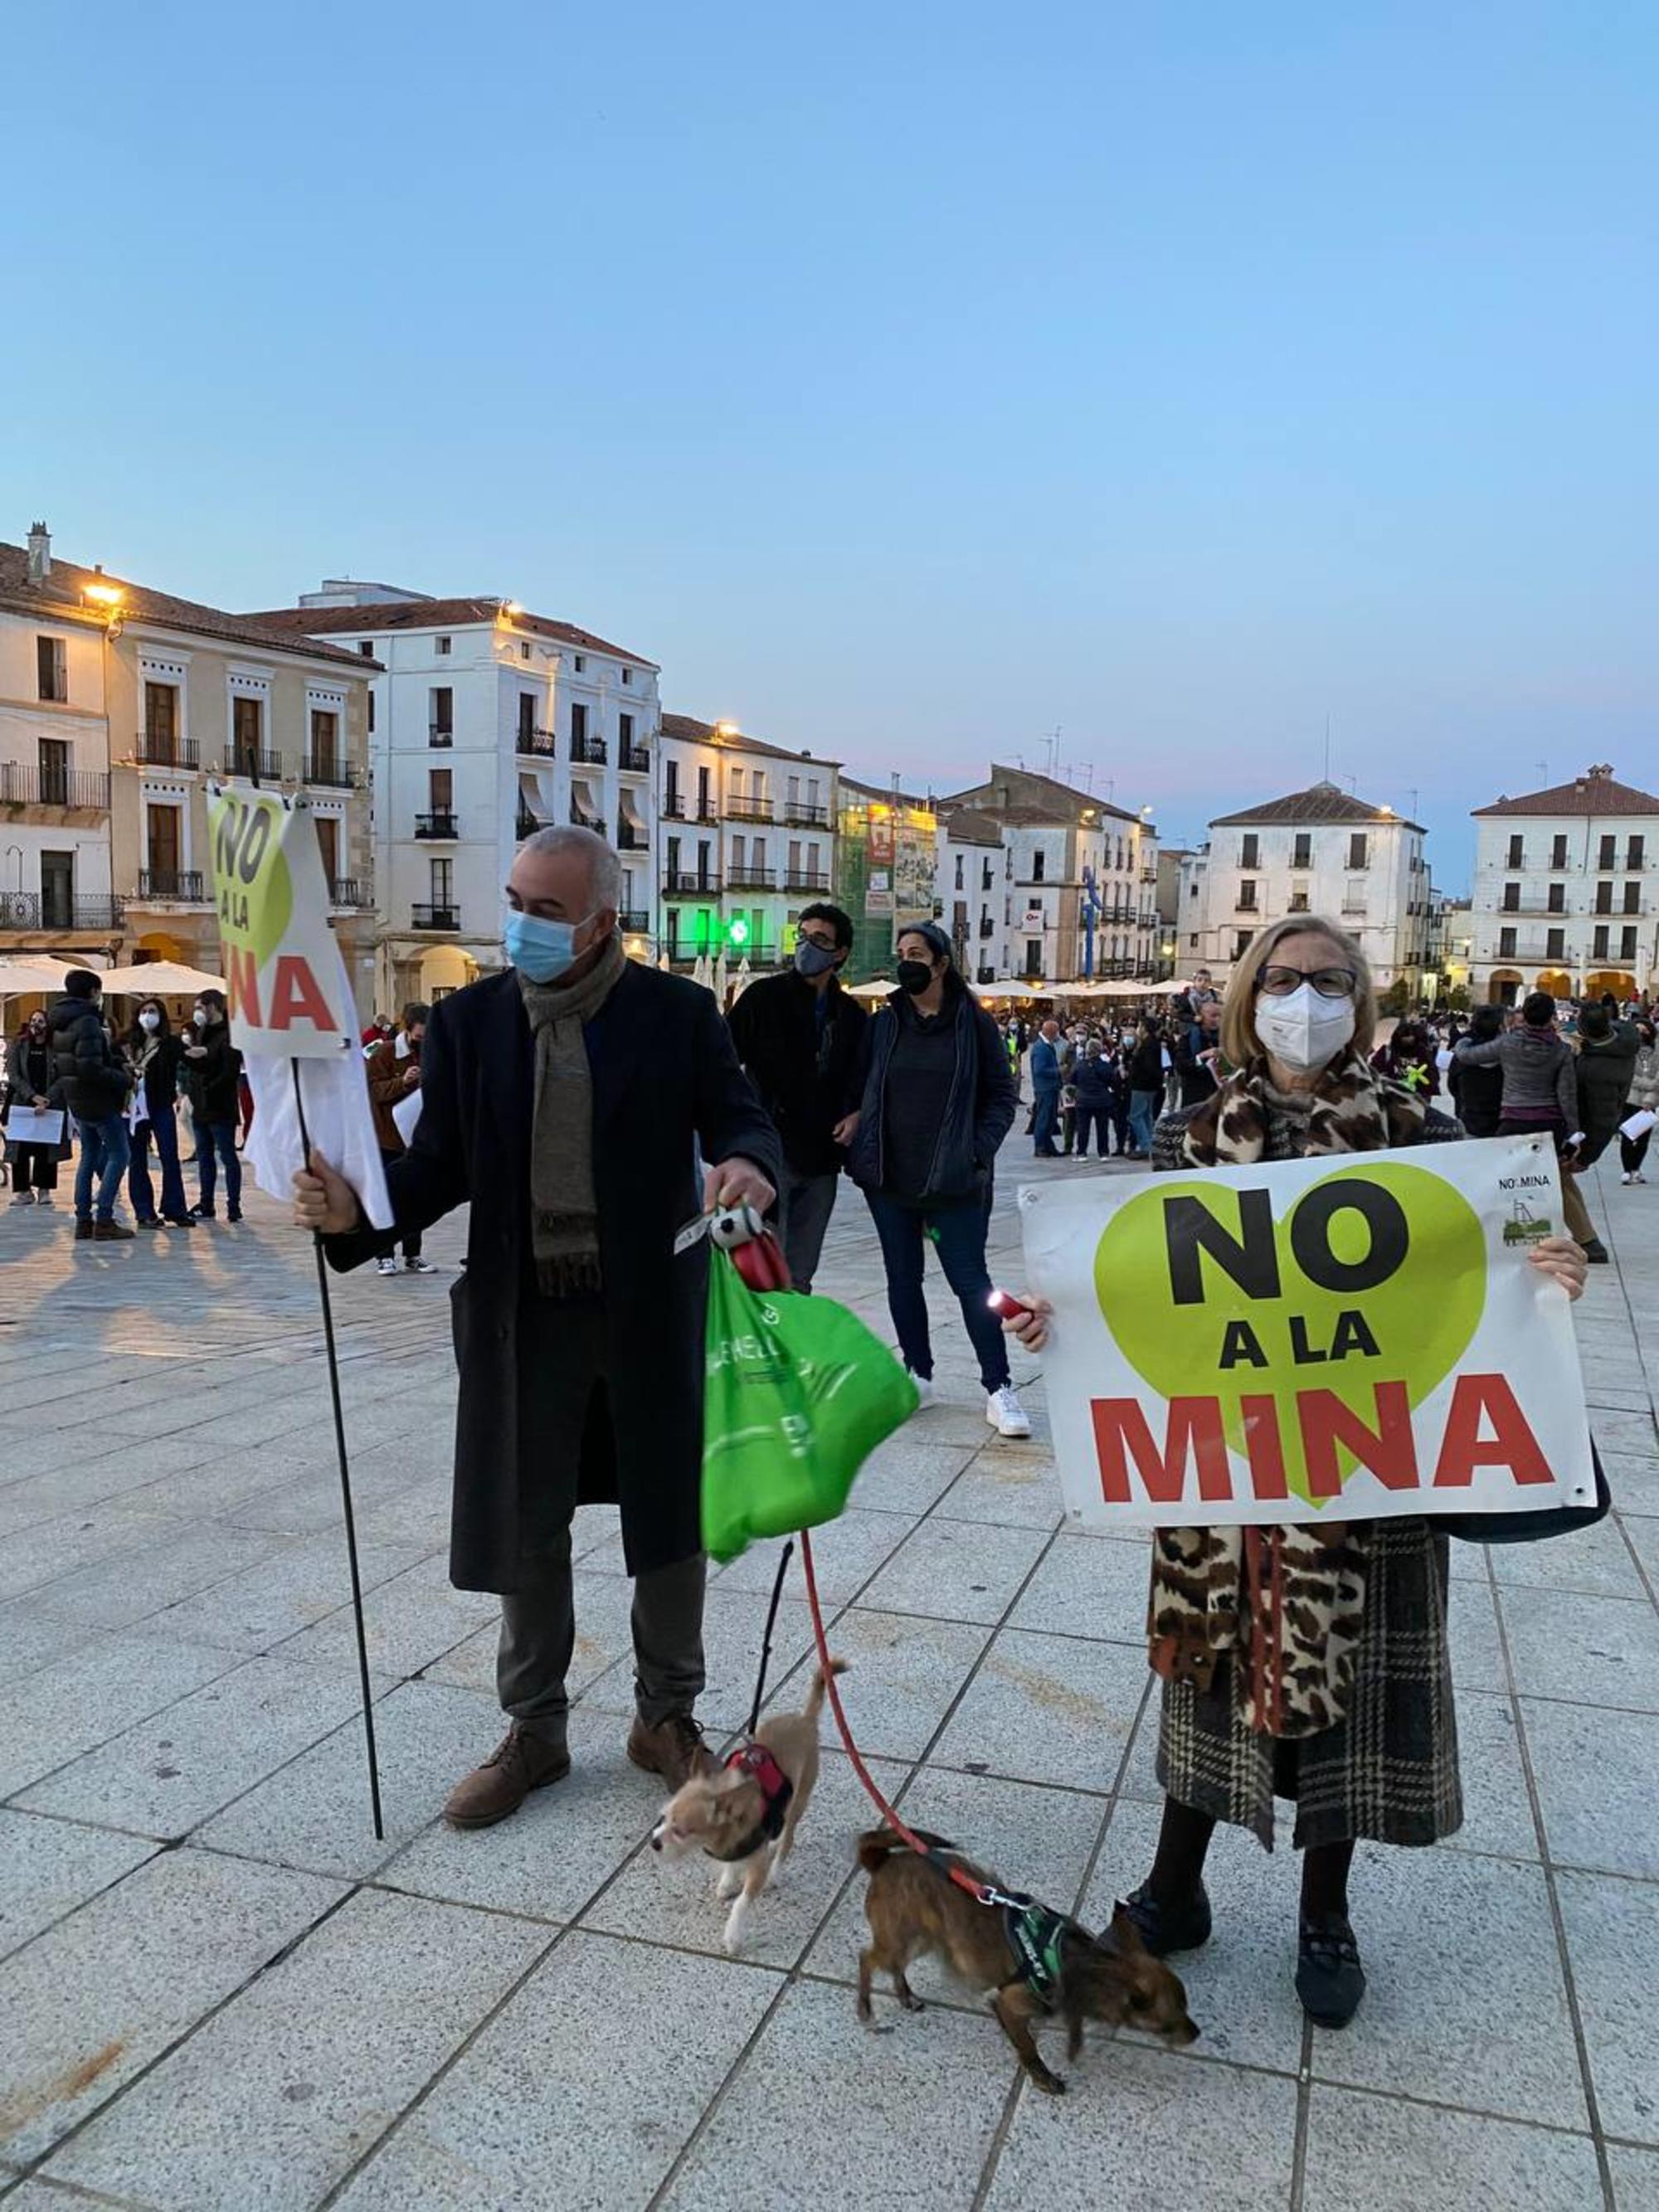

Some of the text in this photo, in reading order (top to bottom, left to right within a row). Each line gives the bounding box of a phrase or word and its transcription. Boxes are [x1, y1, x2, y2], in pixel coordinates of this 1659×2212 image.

[216, 801, 272, 884] NO
[221, 890, 250, 932] A LA
[1499, 1178, 1515, 1190] NO
[1520, 1174, 1550, 1189] MINA
[1163, 1179, 1410, 1305] NO
[1218, 1310, 1382, 1369] A LA
[1090, 1373, 1556, 1503] MINA
